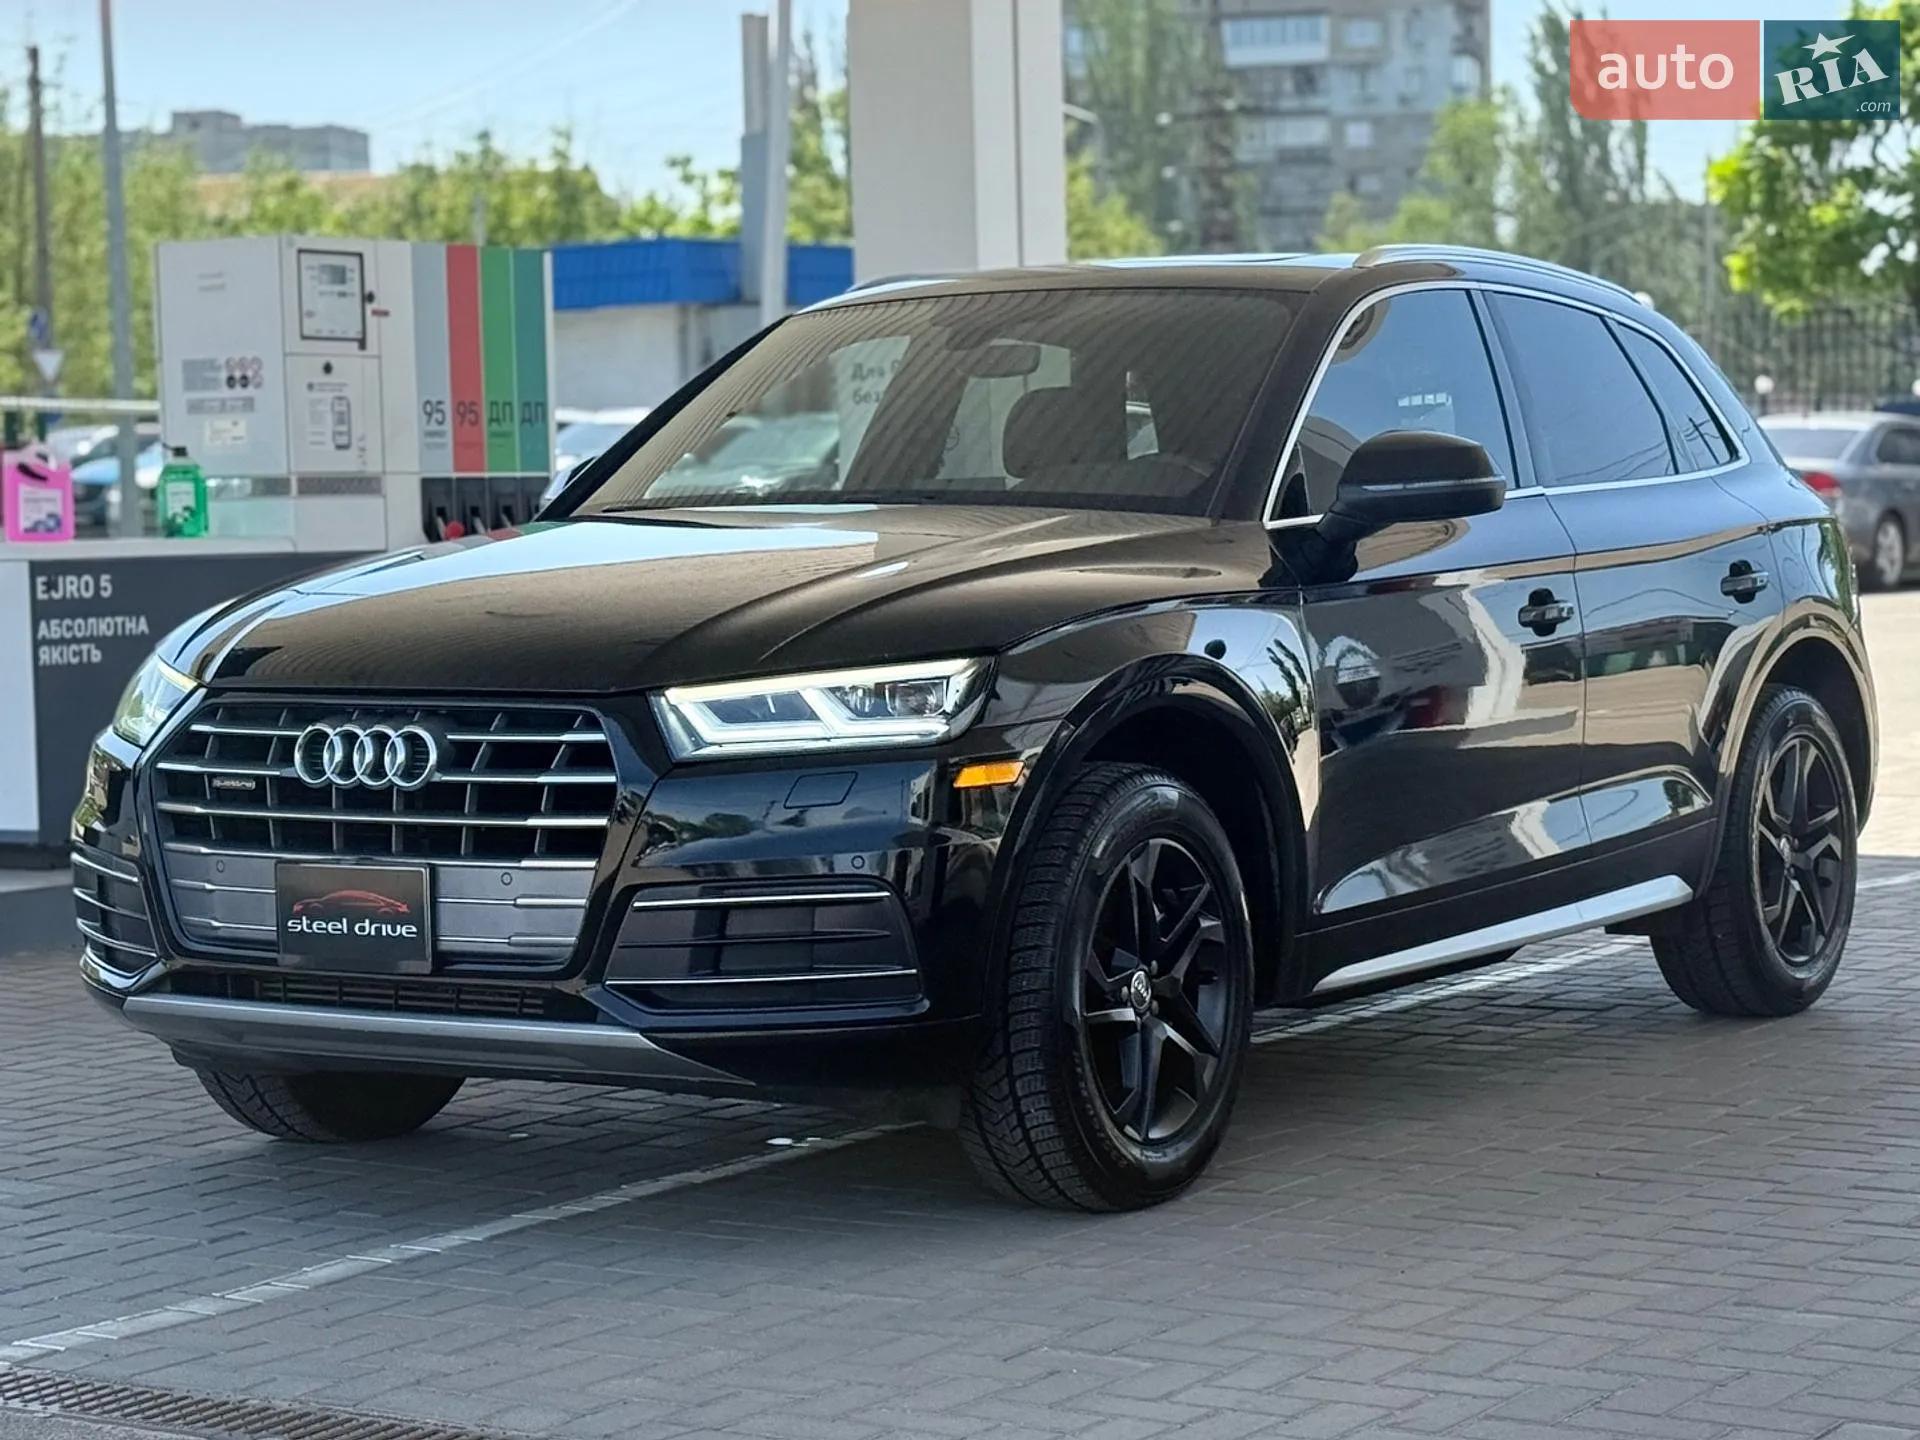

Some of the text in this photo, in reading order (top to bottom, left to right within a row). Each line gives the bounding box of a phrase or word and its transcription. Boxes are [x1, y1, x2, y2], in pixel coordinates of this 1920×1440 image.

[422, 399, 446, 426] 95
[456, 400, 479, 427] 95
[488, 400, 514, 427] ДП
[520, 401, 546, 428] ДП
[99, 573, 113, 599] 5
[37, 615, 150, 640] АБСОЛЮТНА
[38, 642, 103, 667] ЯКІСТЬ
[287, 915, 418, 938] steel drive
